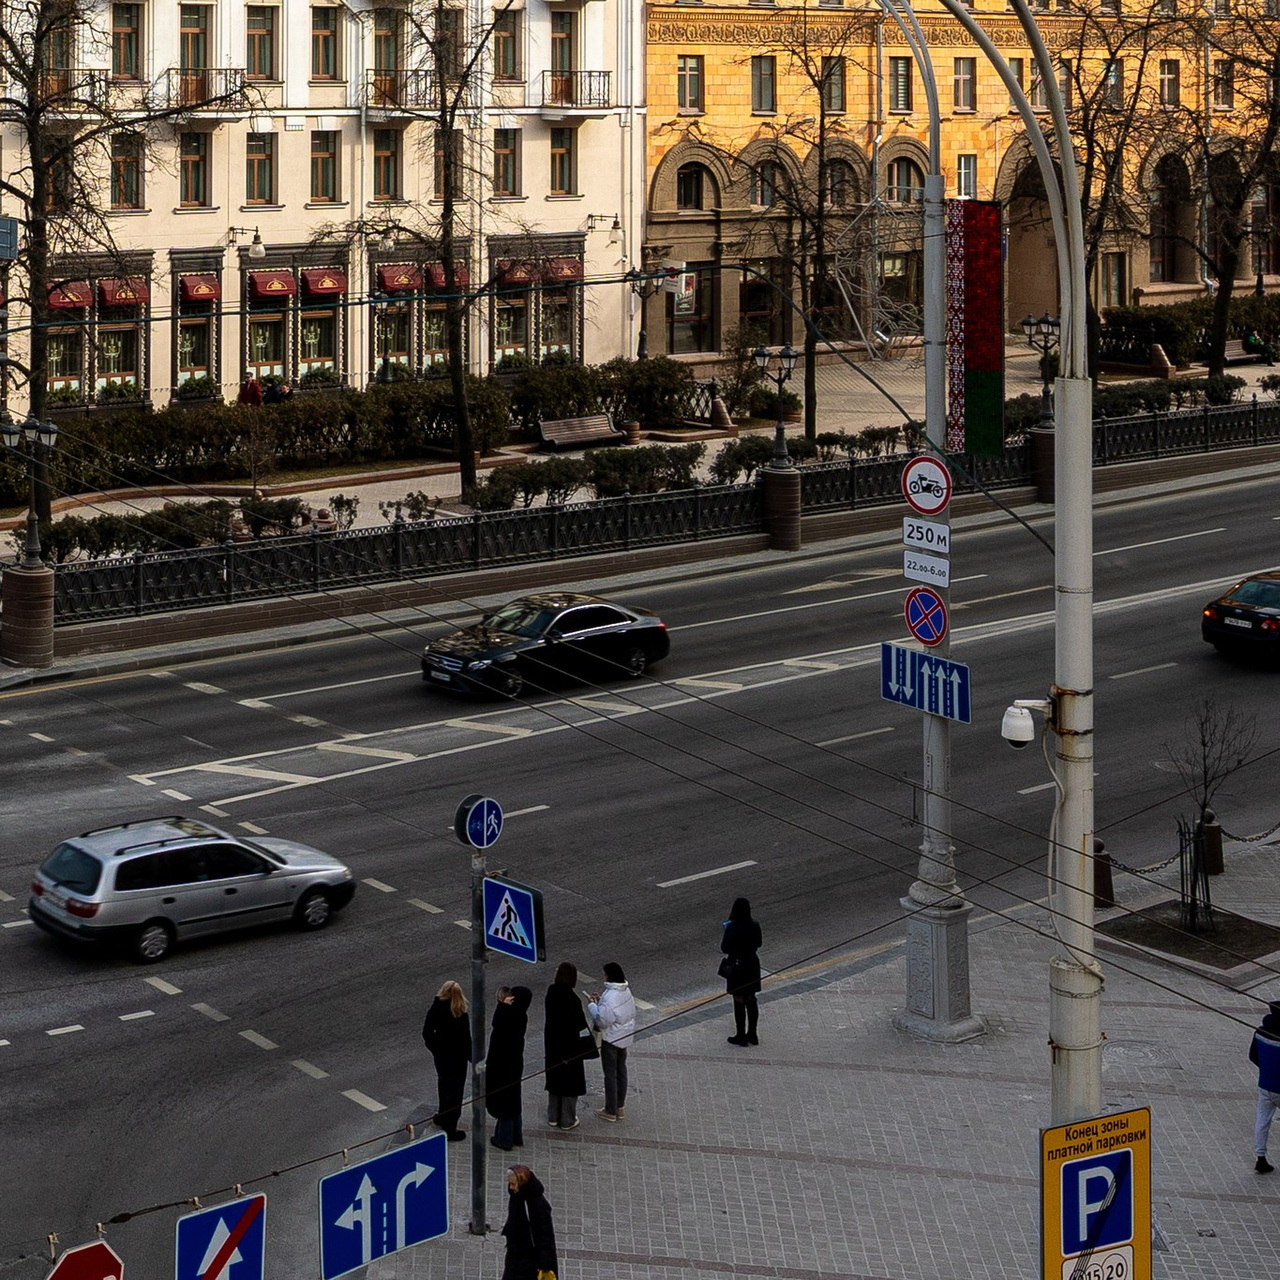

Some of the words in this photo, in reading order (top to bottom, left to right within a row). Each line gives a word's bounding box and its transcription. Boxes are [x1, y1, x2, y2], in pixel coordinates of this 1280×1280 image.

[907, 524, 934, 543] 250
[907, 560, 947, 577] 22.00-6.00
[1065, 1125, 1098, 1141] Конец
[1101, 1118, 1129, 1133] зоны
[1048, 1139, 1093, 1160] платной
[1096, 1129, 1146, 1150] парковки
[1079, 1166, 1117, 1242] P
[1106, 1262, 1124, 1280] 20
